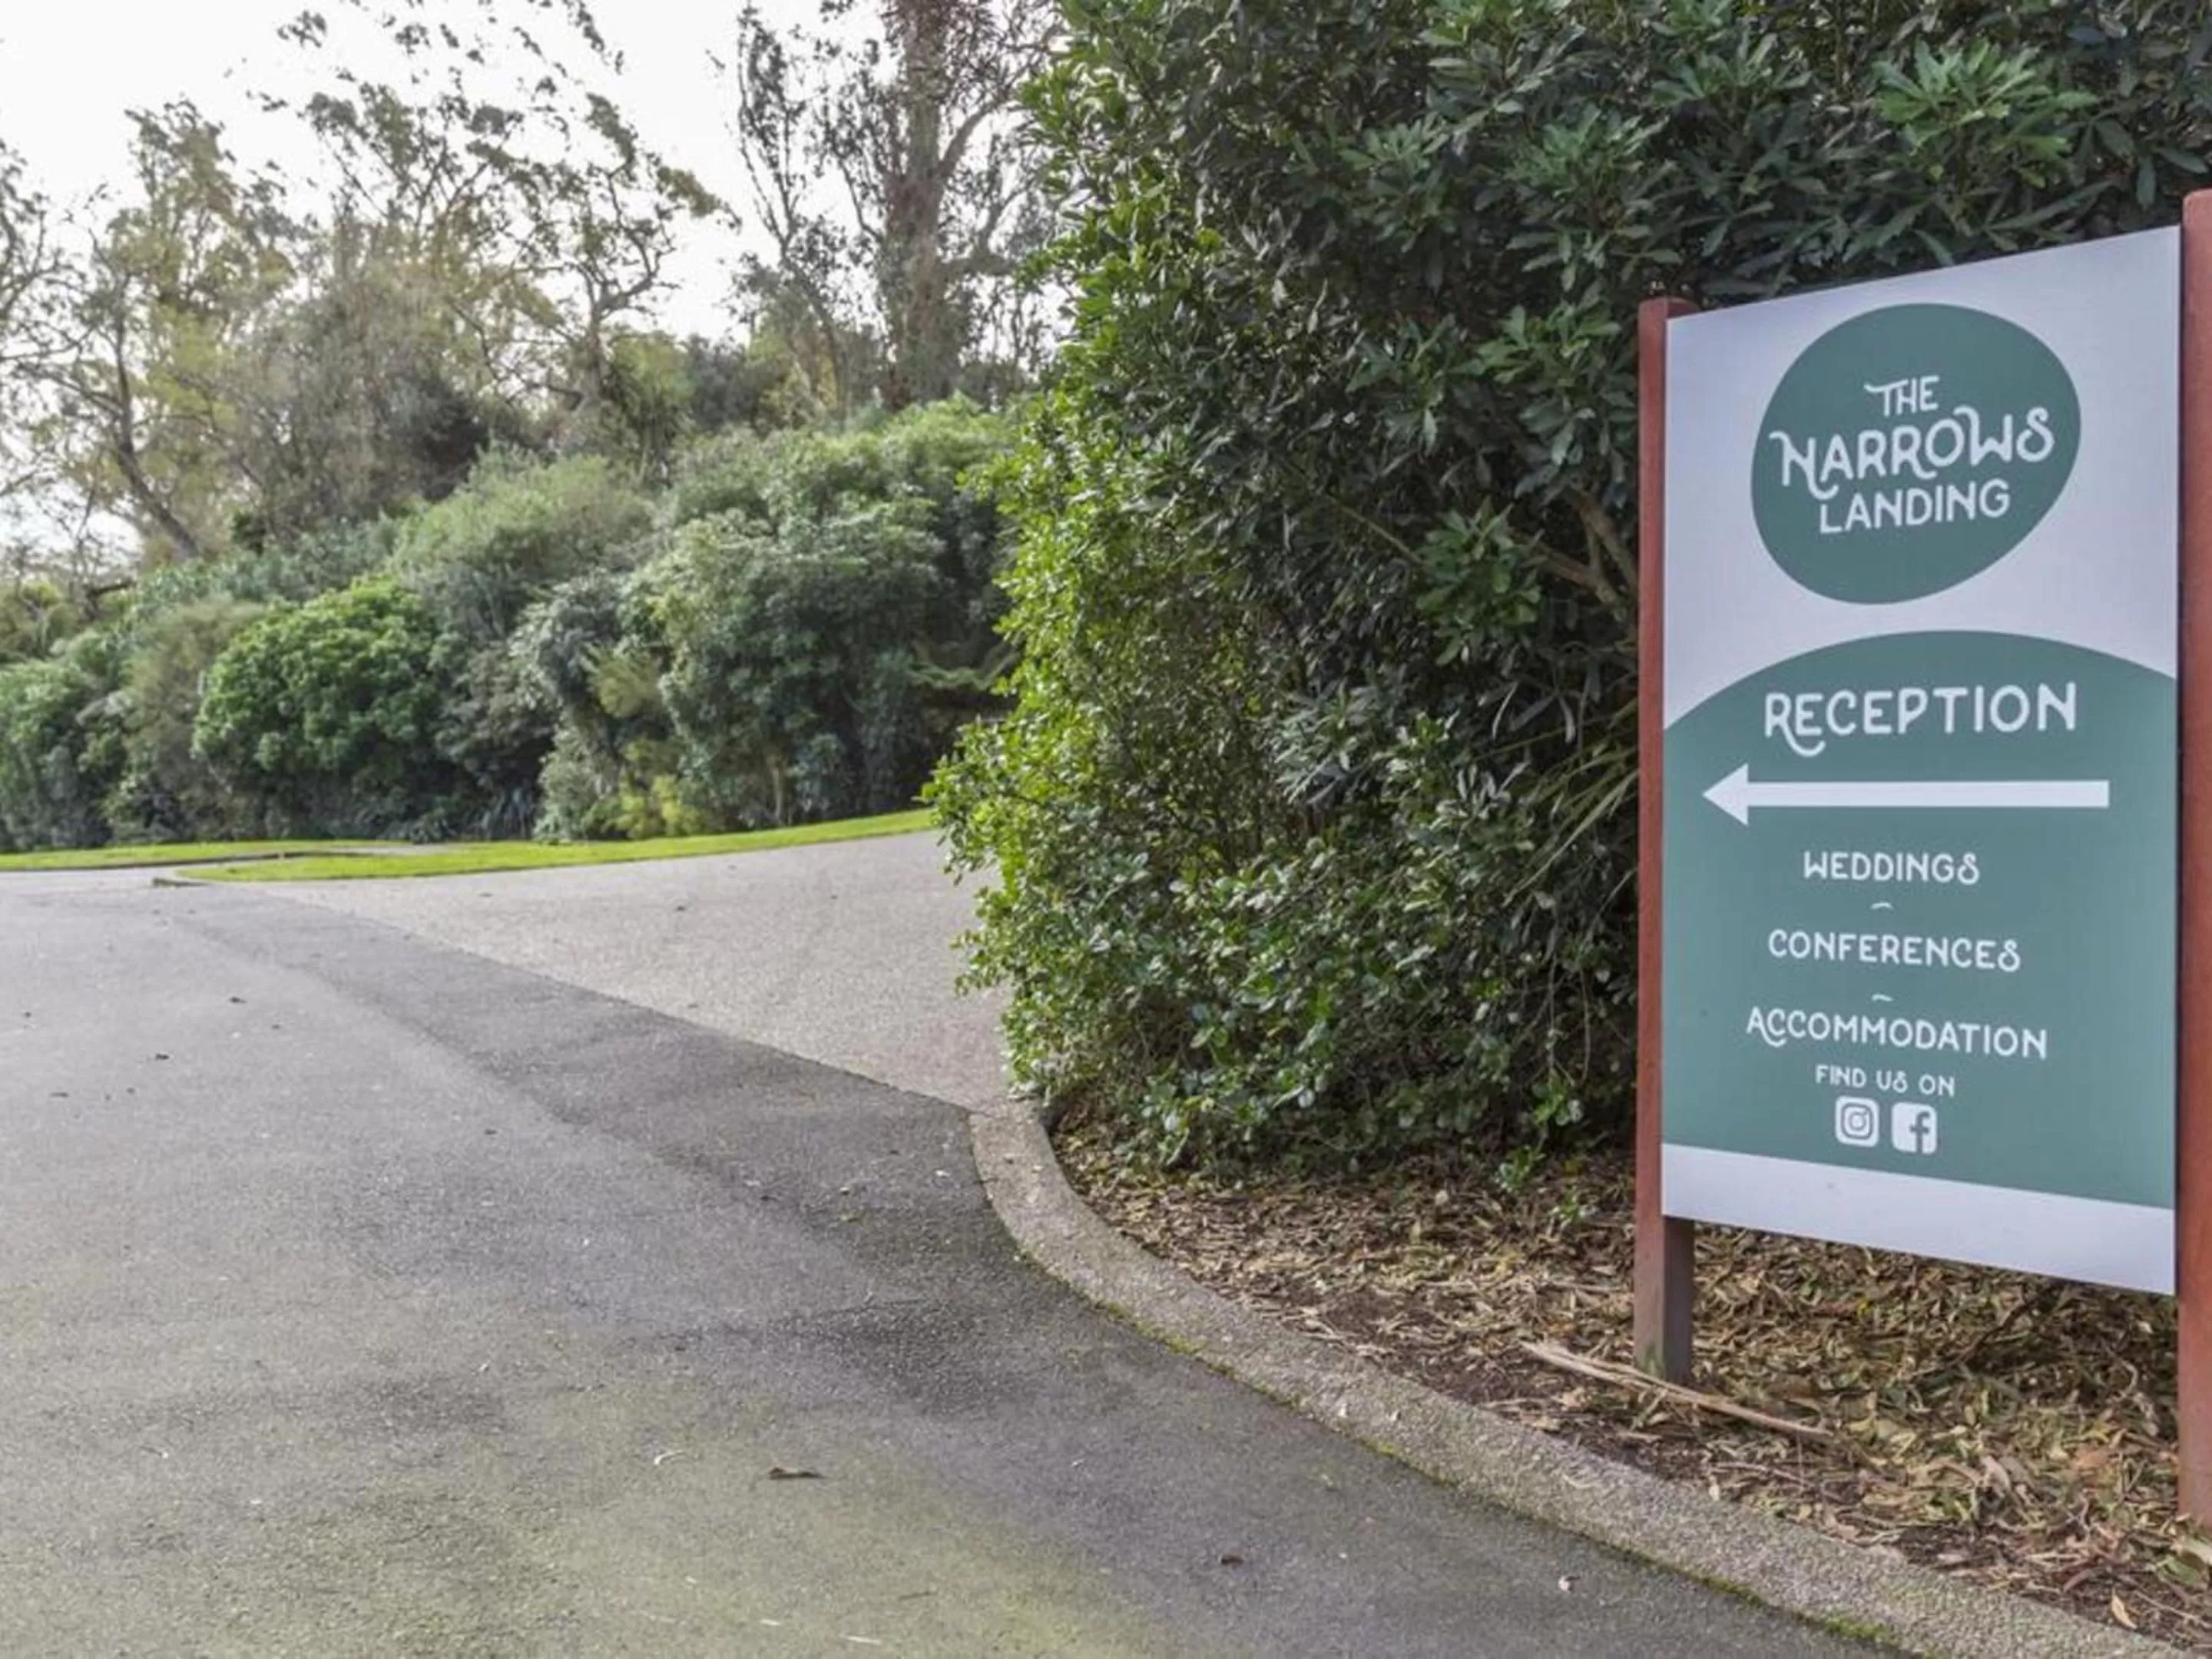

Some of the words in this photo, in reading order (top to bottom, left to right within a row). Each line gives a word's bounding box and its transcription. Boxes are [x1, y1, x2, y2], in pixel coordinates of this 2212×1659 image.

[1864, 376, 1939, 416] THE
[1769, 406, 2055, 500] NARROWS
[1820, 478, 2010, 534] LANDING
[1765, 682, 2076, 757] RECEPTION
[1803, 850, 1980, 886] WEDDINGS
[1768, 929, 2022, 972] CONFERENCES
[1746, 1006, 2047, 1060] ACCOMMODATION
[1815, 1064, 1867, 1088] FIND
[1876, 1070, 1908, 1093] US
[1919, 1073, 1955, 1098] ON
